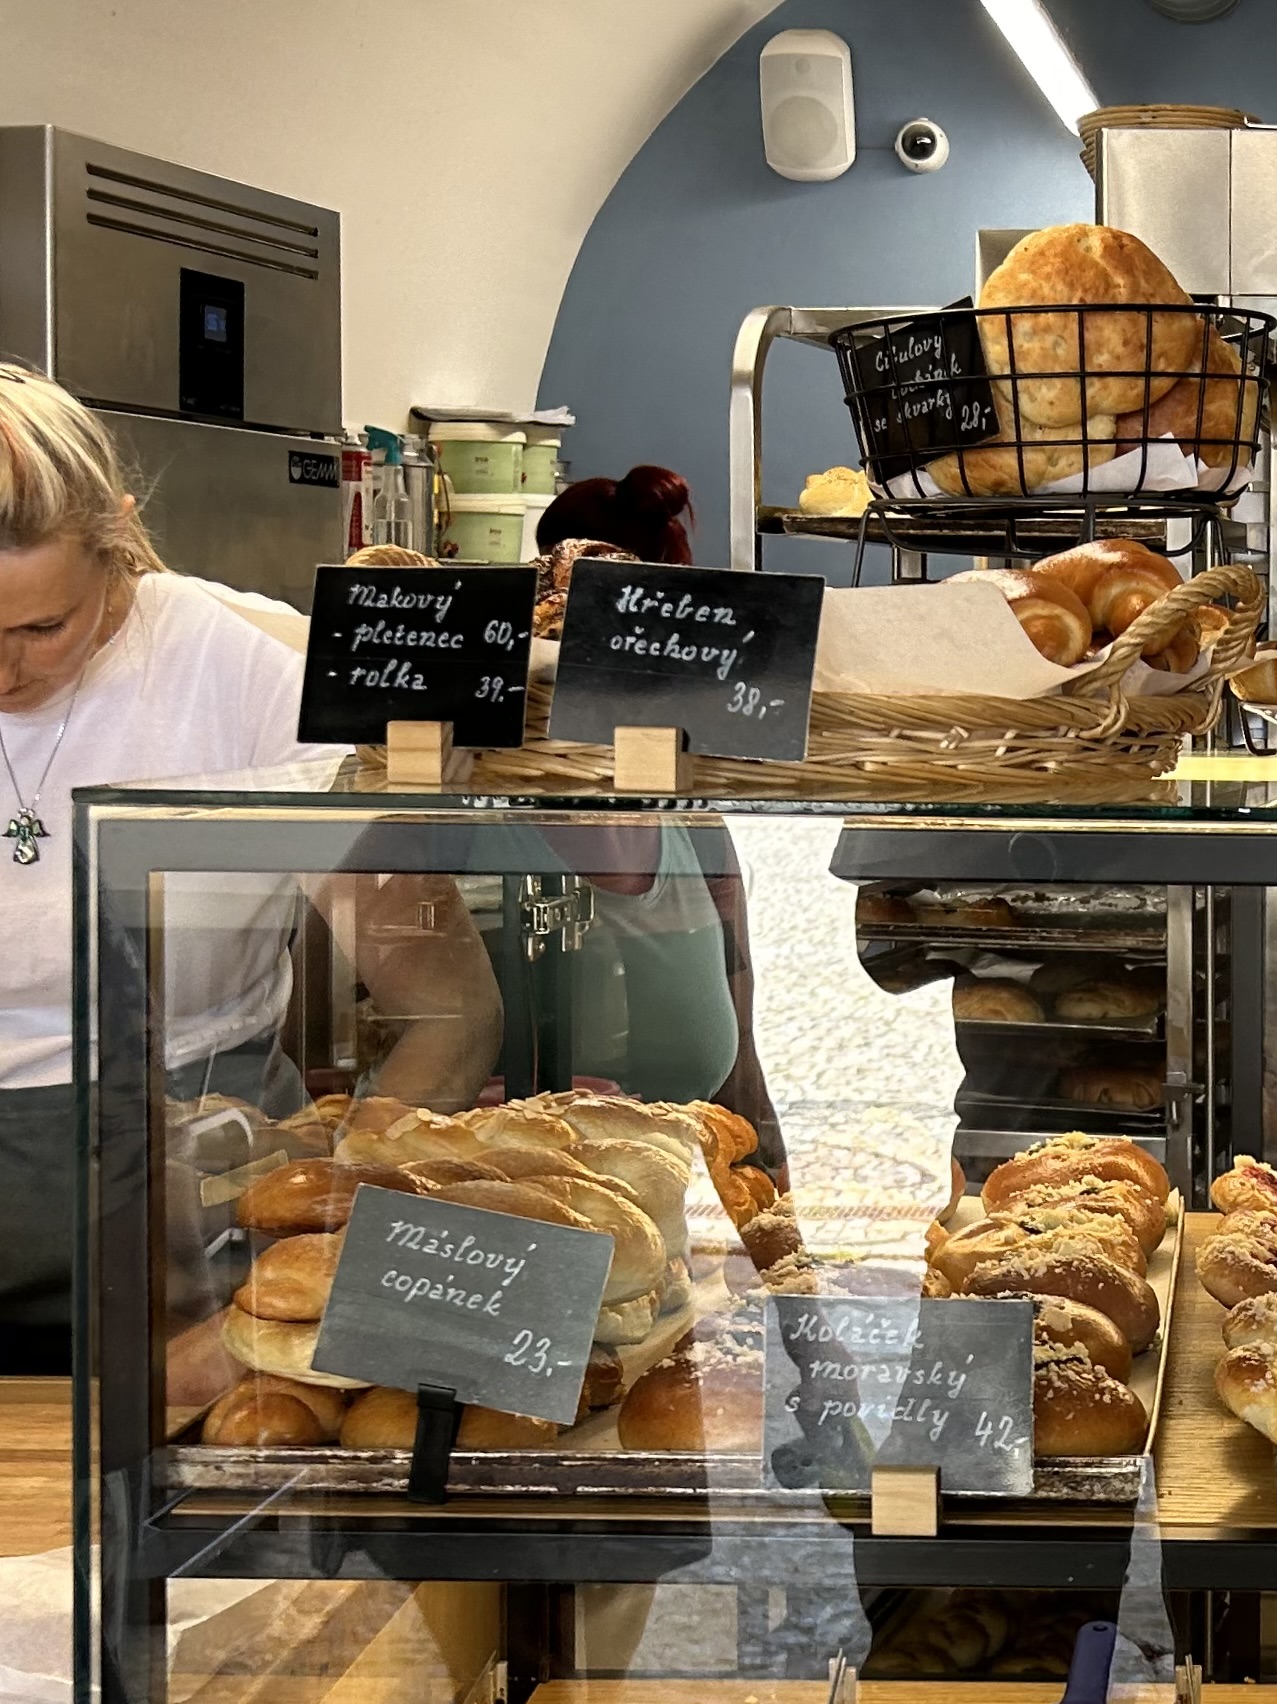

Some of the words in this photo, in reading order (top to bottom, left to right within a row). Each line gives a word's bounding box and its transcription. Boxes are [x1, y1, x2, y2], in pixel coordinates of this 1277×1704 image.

[873, 417, 888, 433] se
[347, 579, 462, 624] Makový
[615, 584, 738, 627] Hřeben
[351, 619, 465, 653] pletenec
[609, 626, 755, 681] ořechový
[348, 657, 428, 691] rolka
[385, 1219, 537, 1287] Máslový
[380, 1269, 503, 1317] copánek
[788, 1312, 925, 1350] Koláček
[808, 1352, 975, 1399] moravský
[817, 1395, 950, 1443] povidly
